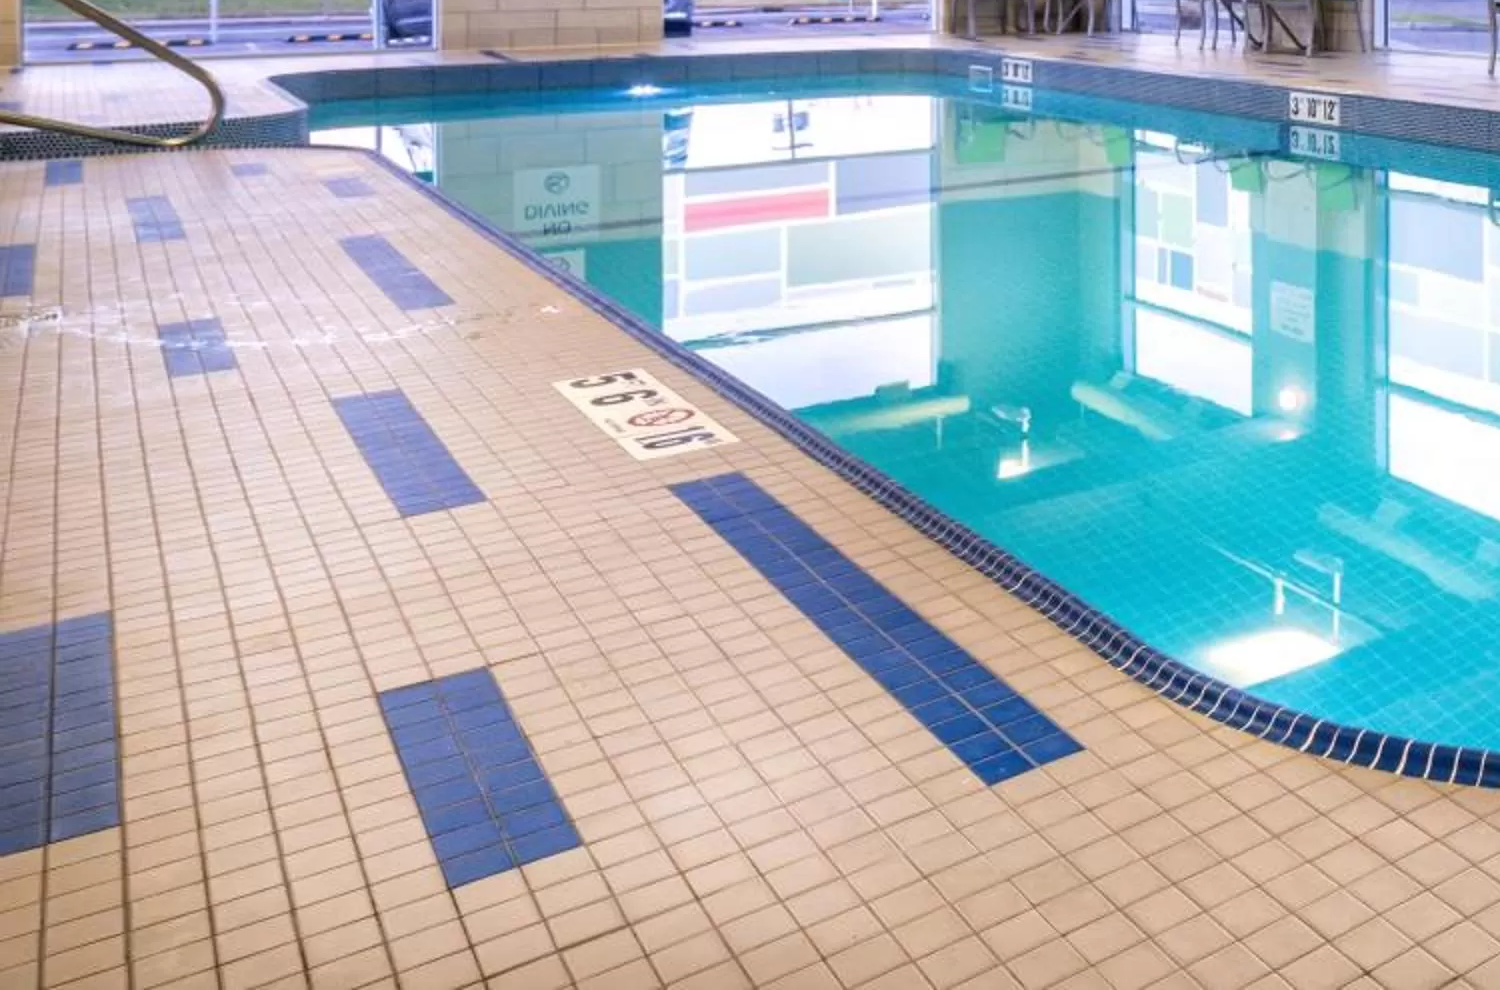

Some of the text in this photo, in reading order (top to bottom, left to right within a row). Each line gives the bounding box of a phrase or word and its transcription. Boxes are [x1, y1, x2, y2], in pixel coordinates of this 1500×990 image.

[1292, 97, 1299, 115] 3
[569, 371, 637, 388] 5
[590, 389, 657, 406] 6
